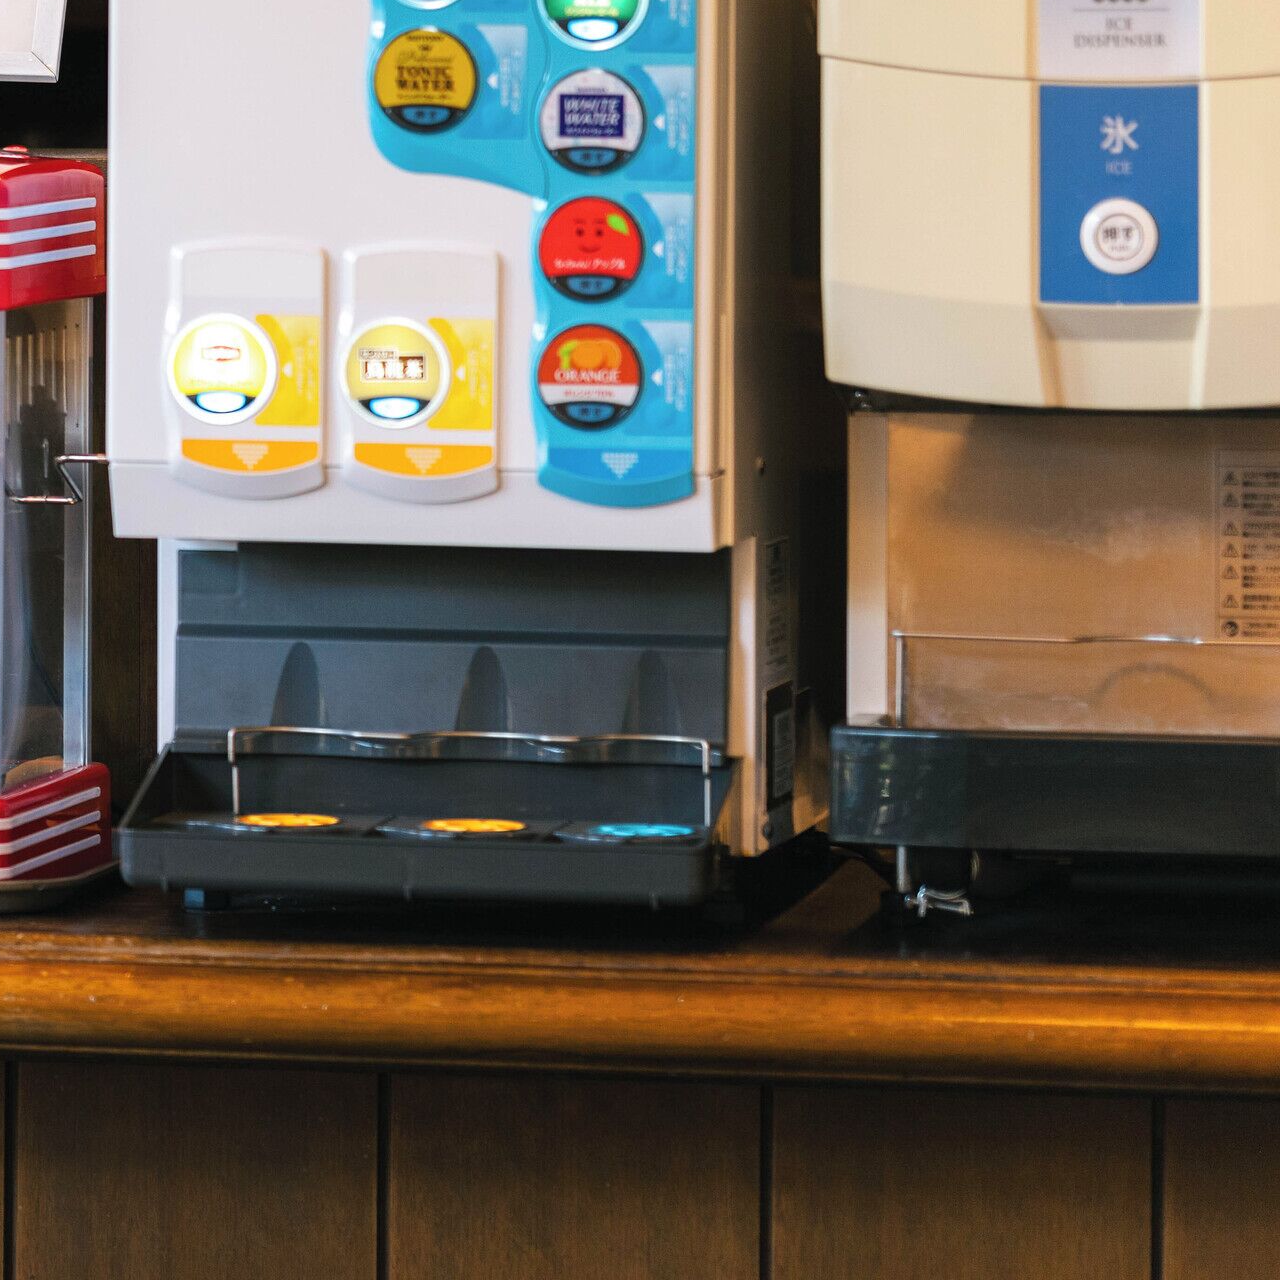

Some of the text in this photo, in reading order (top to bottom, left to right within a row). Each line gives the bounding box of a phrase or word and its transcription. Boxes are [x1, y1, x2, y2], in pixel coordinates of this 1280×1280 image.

[1073, 34, 1168, 48] DISPENSER
[396, 79, 455, 92] WATER
[1100, 116, 1139, 154] 氷
[553, 367, 621, 383] ORANGE
